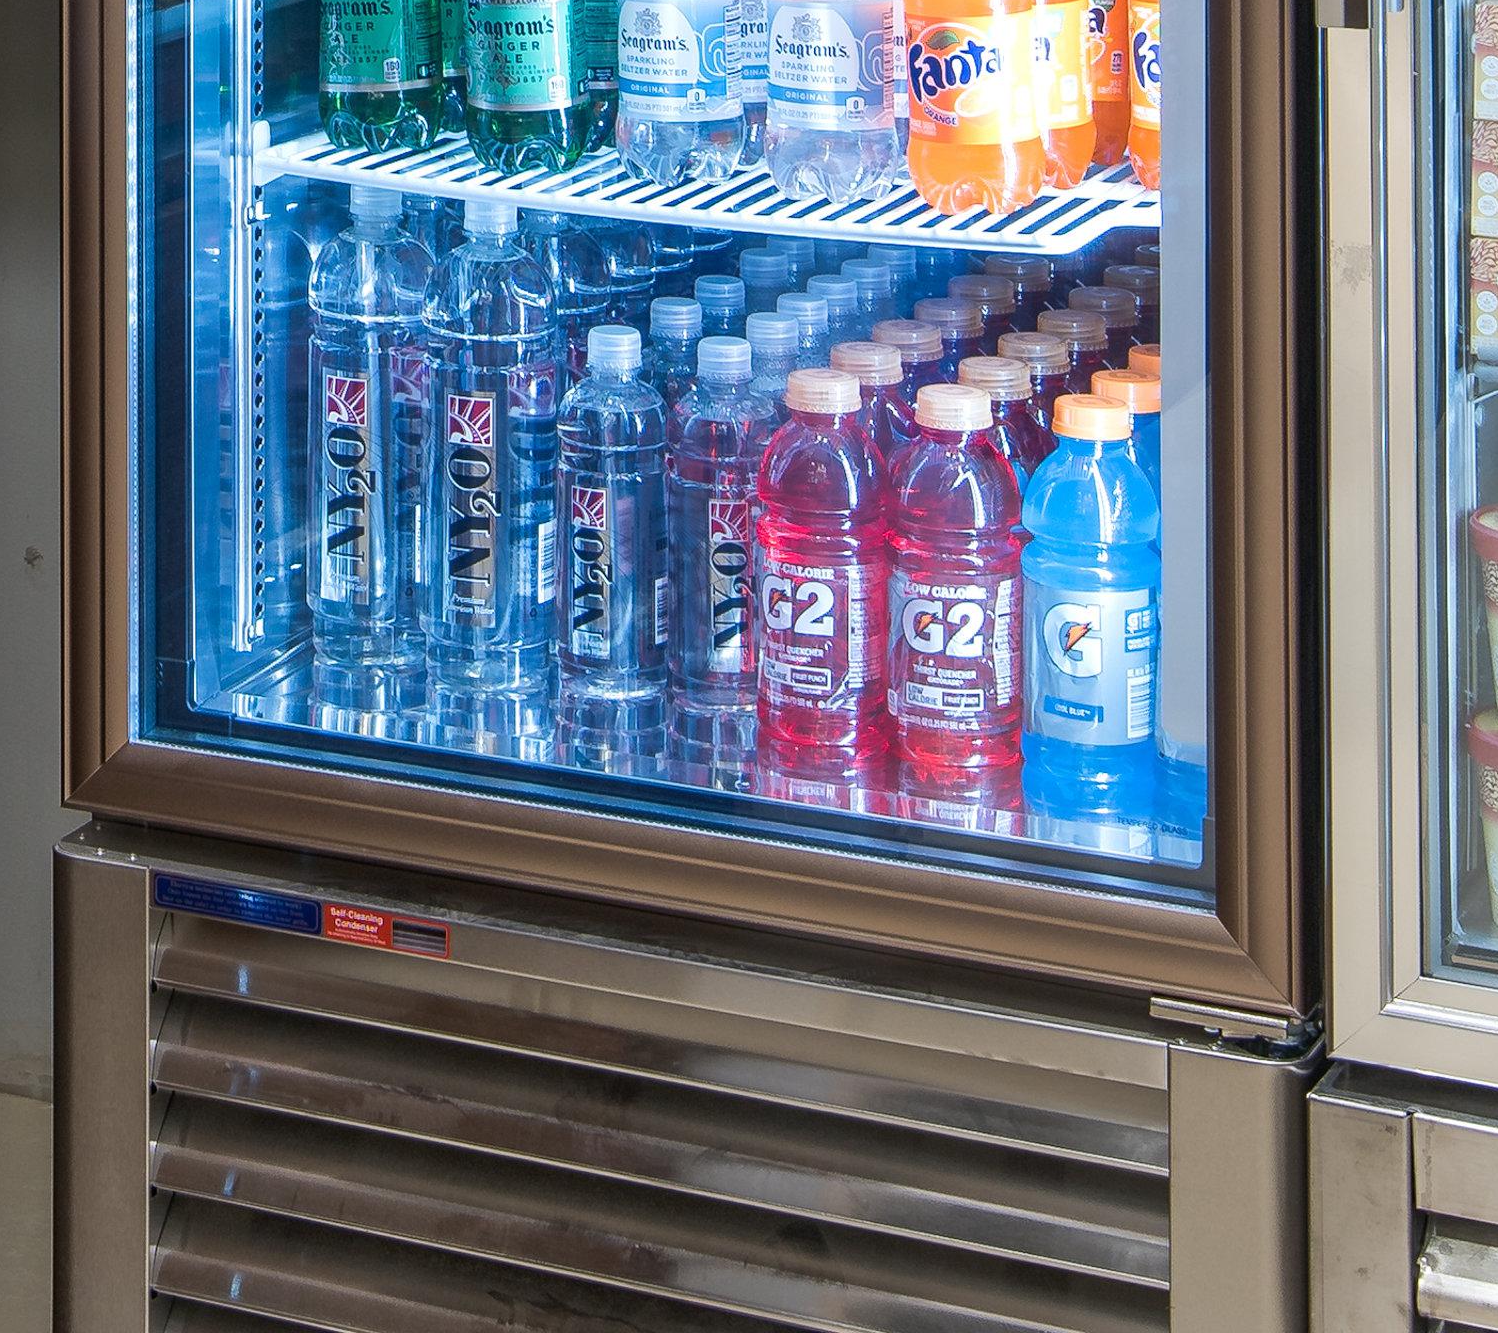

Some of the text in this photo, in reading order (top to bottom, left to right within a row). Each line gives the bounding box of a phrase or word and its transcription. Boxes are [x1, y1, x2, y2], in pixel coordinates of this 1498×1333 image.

[467, 11, 556, 38] Seagram's
[477, 40, 541, 52] GINGER
[620, 29, 689, 53] Seagram's
[774, 36, 851, 62] Seagram's
[492, 53, 525, 65] ALE
[625, 55, 676, 67] SPARKLING
[653, 67, 688, 77] WATER
[630, 84, 670, 95] ORIGINAL
[784, 90, 829, 102] ORIGINAL
[923, 104, 958, 126] ORANGE
[761, 574, 836, 637] G2
[902, 595, 986, 660] G2
[1044, 602, 1104, 679] G
